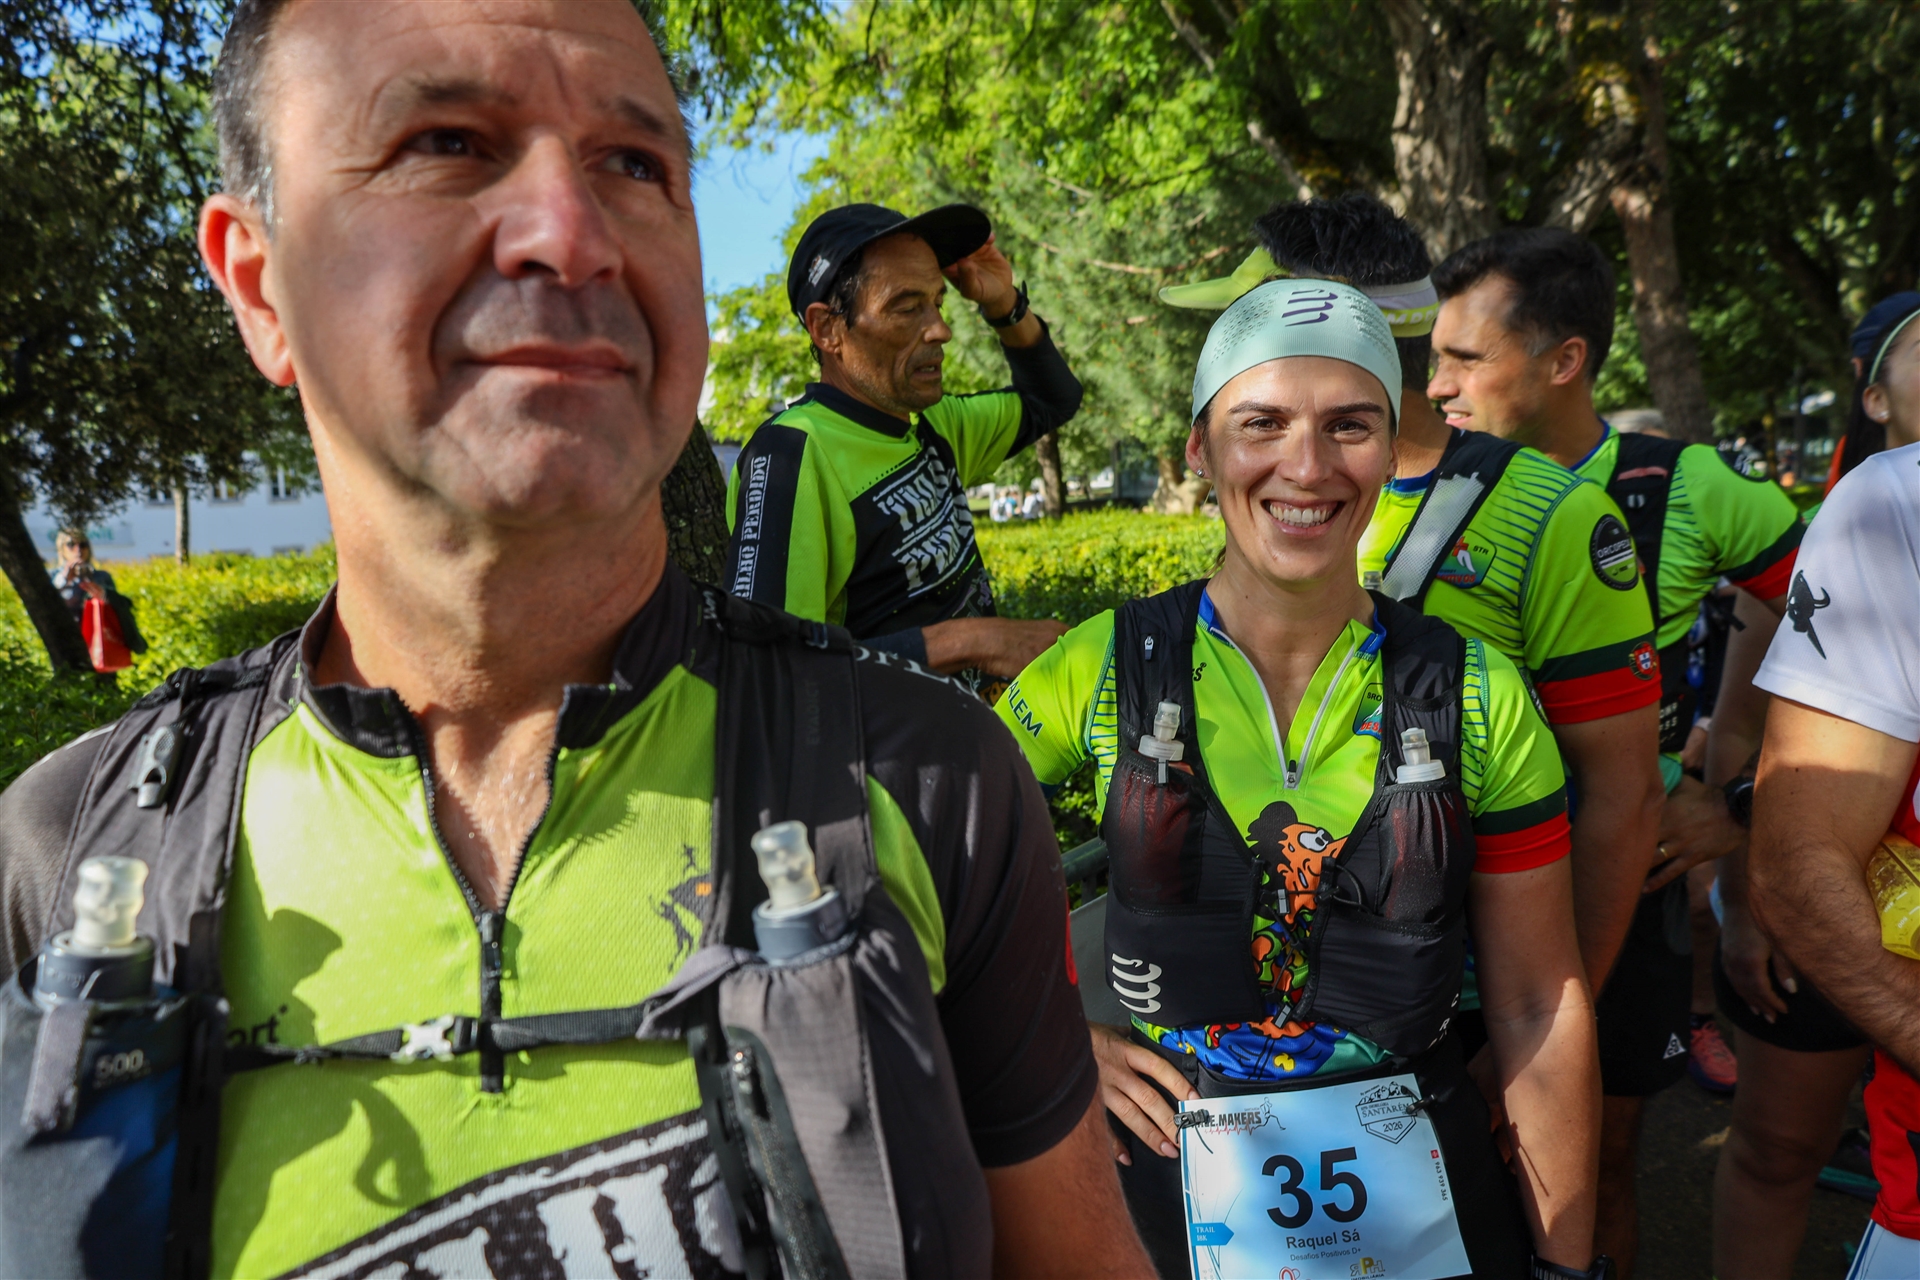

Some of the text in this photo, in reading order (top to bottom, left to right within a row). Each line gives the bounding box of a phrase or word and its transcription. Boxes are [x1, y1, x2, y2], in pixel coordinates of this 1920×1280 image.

[734, 455, 768, 600] RILHO PERDIDO
[1383, 1121, 1403, 1132] 2026
[1262, 1147, 1368, 1229] 35
[1286, 1229, 1360, 1249] Raquel Sá
[1290, 1253, 1319, 1261] Desafios
[1321, 1248, 1350, 1258] Positivos
